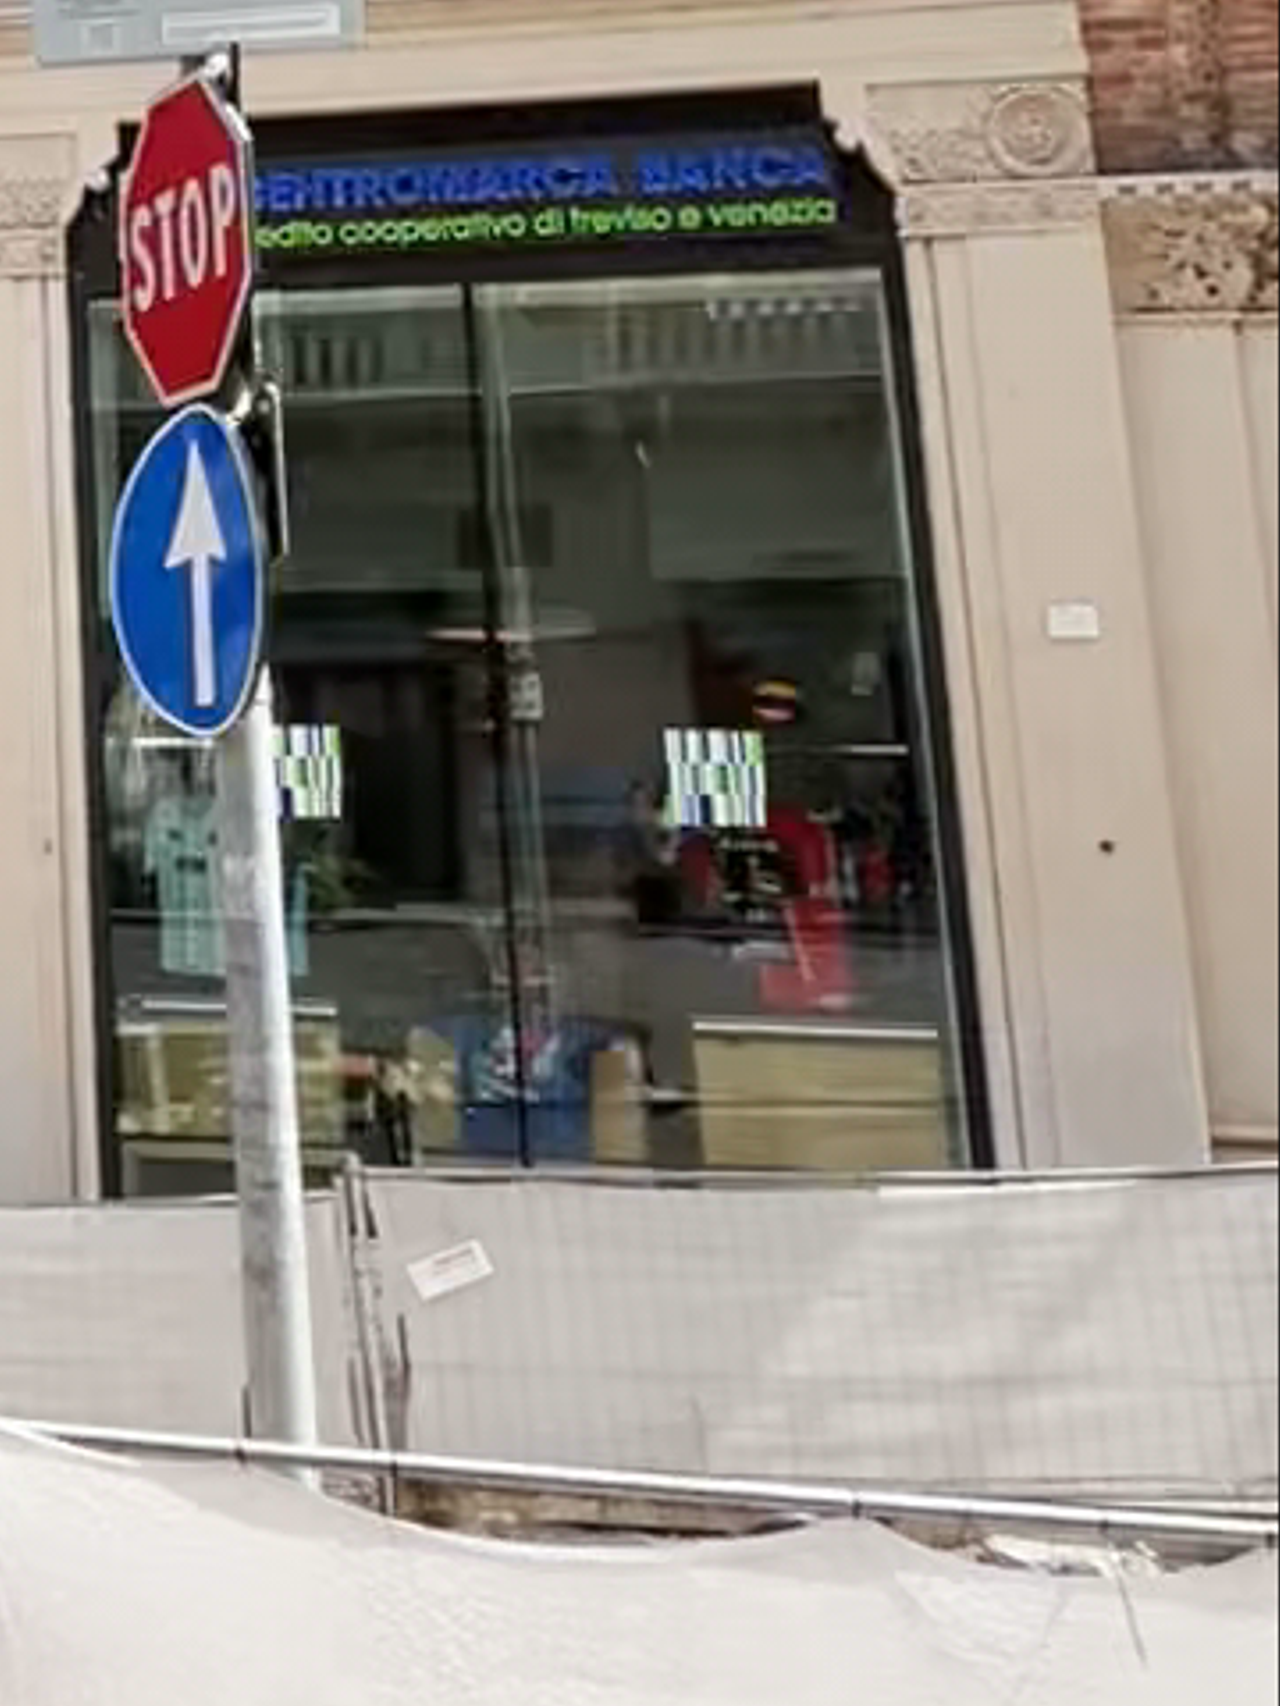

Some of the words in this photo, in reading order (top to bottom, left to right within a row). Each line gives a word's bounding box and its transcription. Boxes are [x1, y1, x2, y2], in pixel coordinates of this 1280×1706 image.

[254, 154, 618, 211] ENTROMARCA
[640, 148, 828, 194] BANCA
[130, 161, 235, 313] STOP
[254, 222, 333, 248] edito
[339, 213, 526, 250] cooperativo
[534, 206, 566, 235] di
[569, 203, 672, 234] treviso
[677, 204, 703, 230] e
[707, 196, 837, 227] venezia
